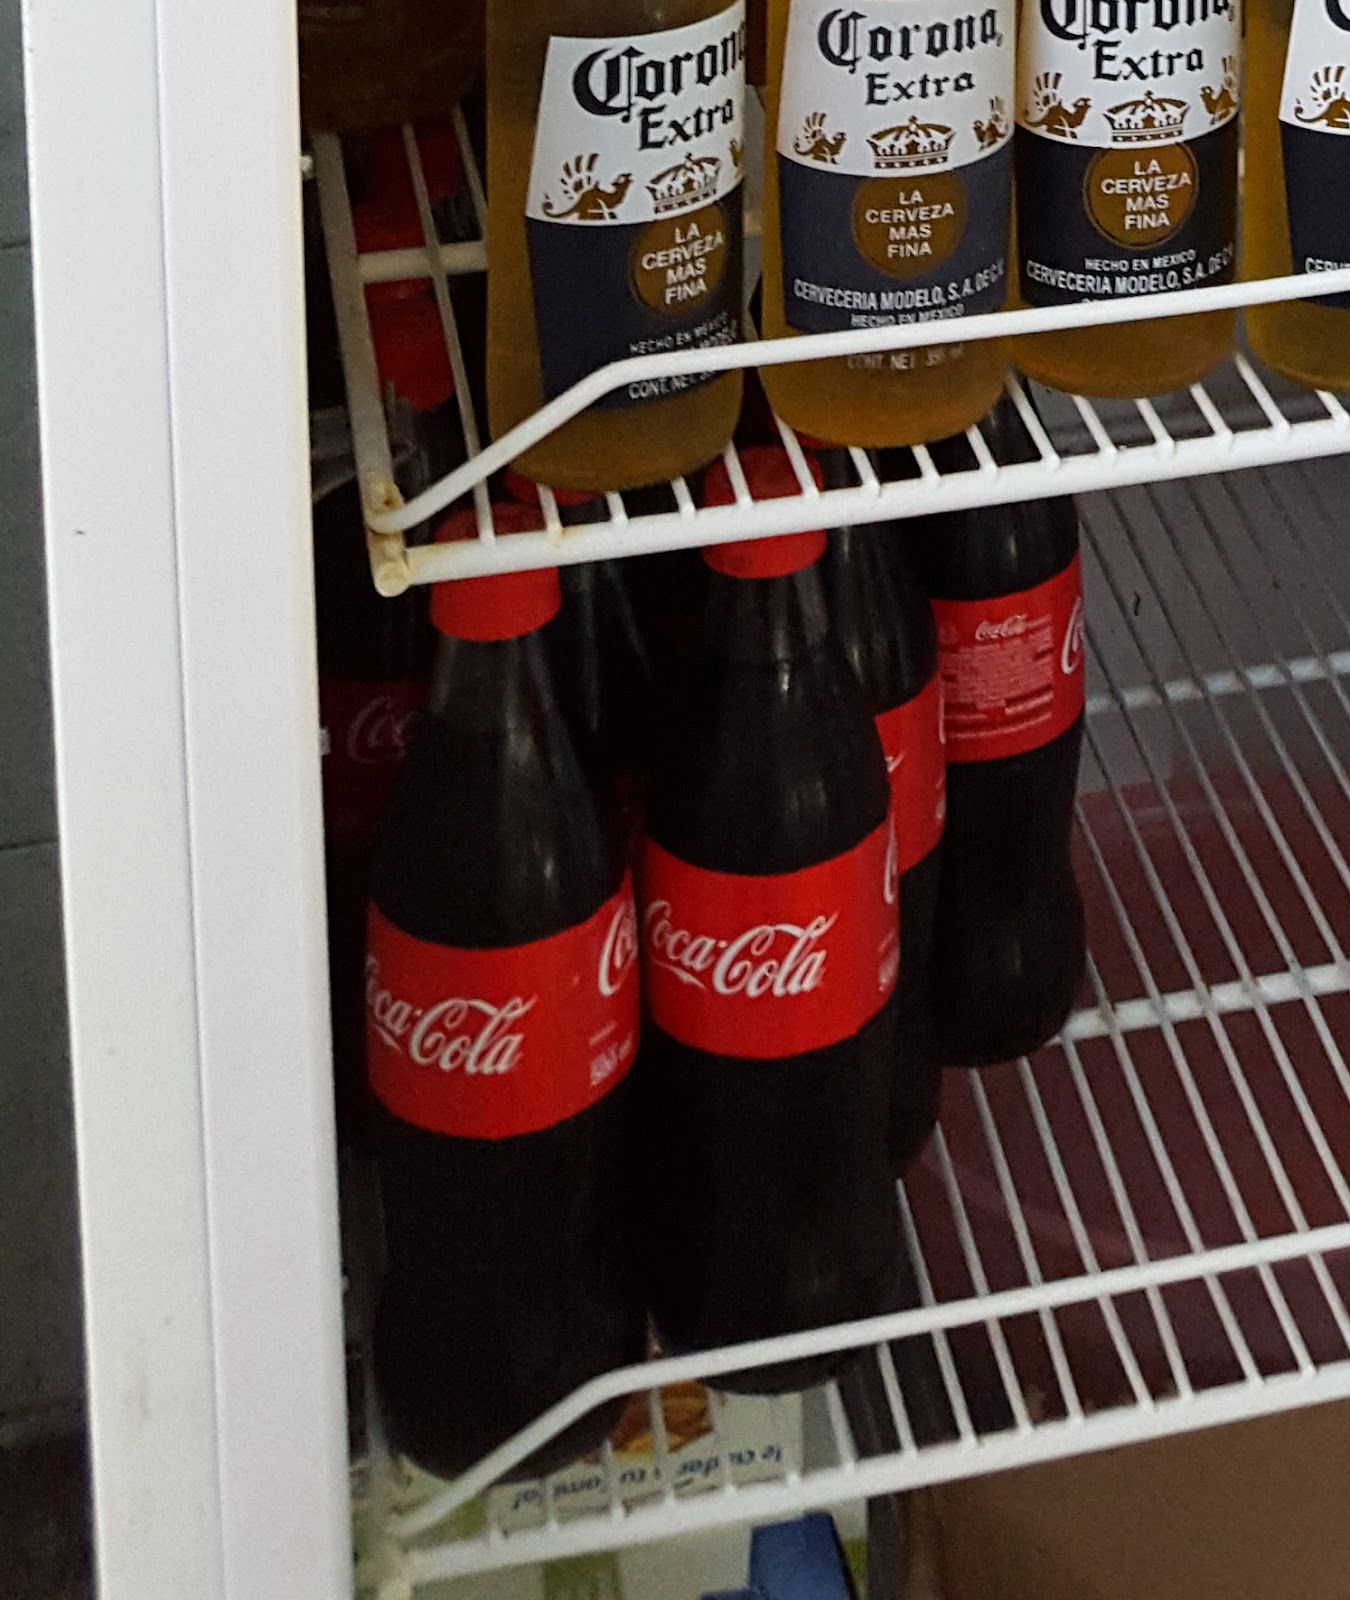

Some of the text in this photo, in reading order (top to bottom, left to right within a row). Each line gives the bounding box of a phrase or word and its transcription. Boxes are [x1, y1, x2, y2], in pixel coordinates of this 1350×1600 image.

[818, 8, 999, 75] Corona
[1092, 40, 1205, 82] Extra
[865, 71, 976, 106] Extra
[638, 98, 735, 152] Extra
[1134, 158, 1162, 176] LA
[1101, 171, 1193, 195] CERVEZA
[899, 189, 924, 205] LA
[1125, 195, 1170, 212] MAS
[865, 201, 954, 225] CERVEZA
[1124, 213, 1171, 230] FINA
[675, 221, 701, 244] LA
[888, 226, 933, 242] MAS
[642, 230, 725, 271] CERVEZA
[887, 242, 933, 258] FINA
[1084, 249, 1197, 272] HECHO EN MEXICO
[666, 257, 707, 286] MAS
[1026, 260, 1114, 295] CERVECERIA
[665, 277, 708, 305] FINA
[793, 278, 878, 311] CERVECERIA
[366, 954, 538, 1076] ca-Cola
